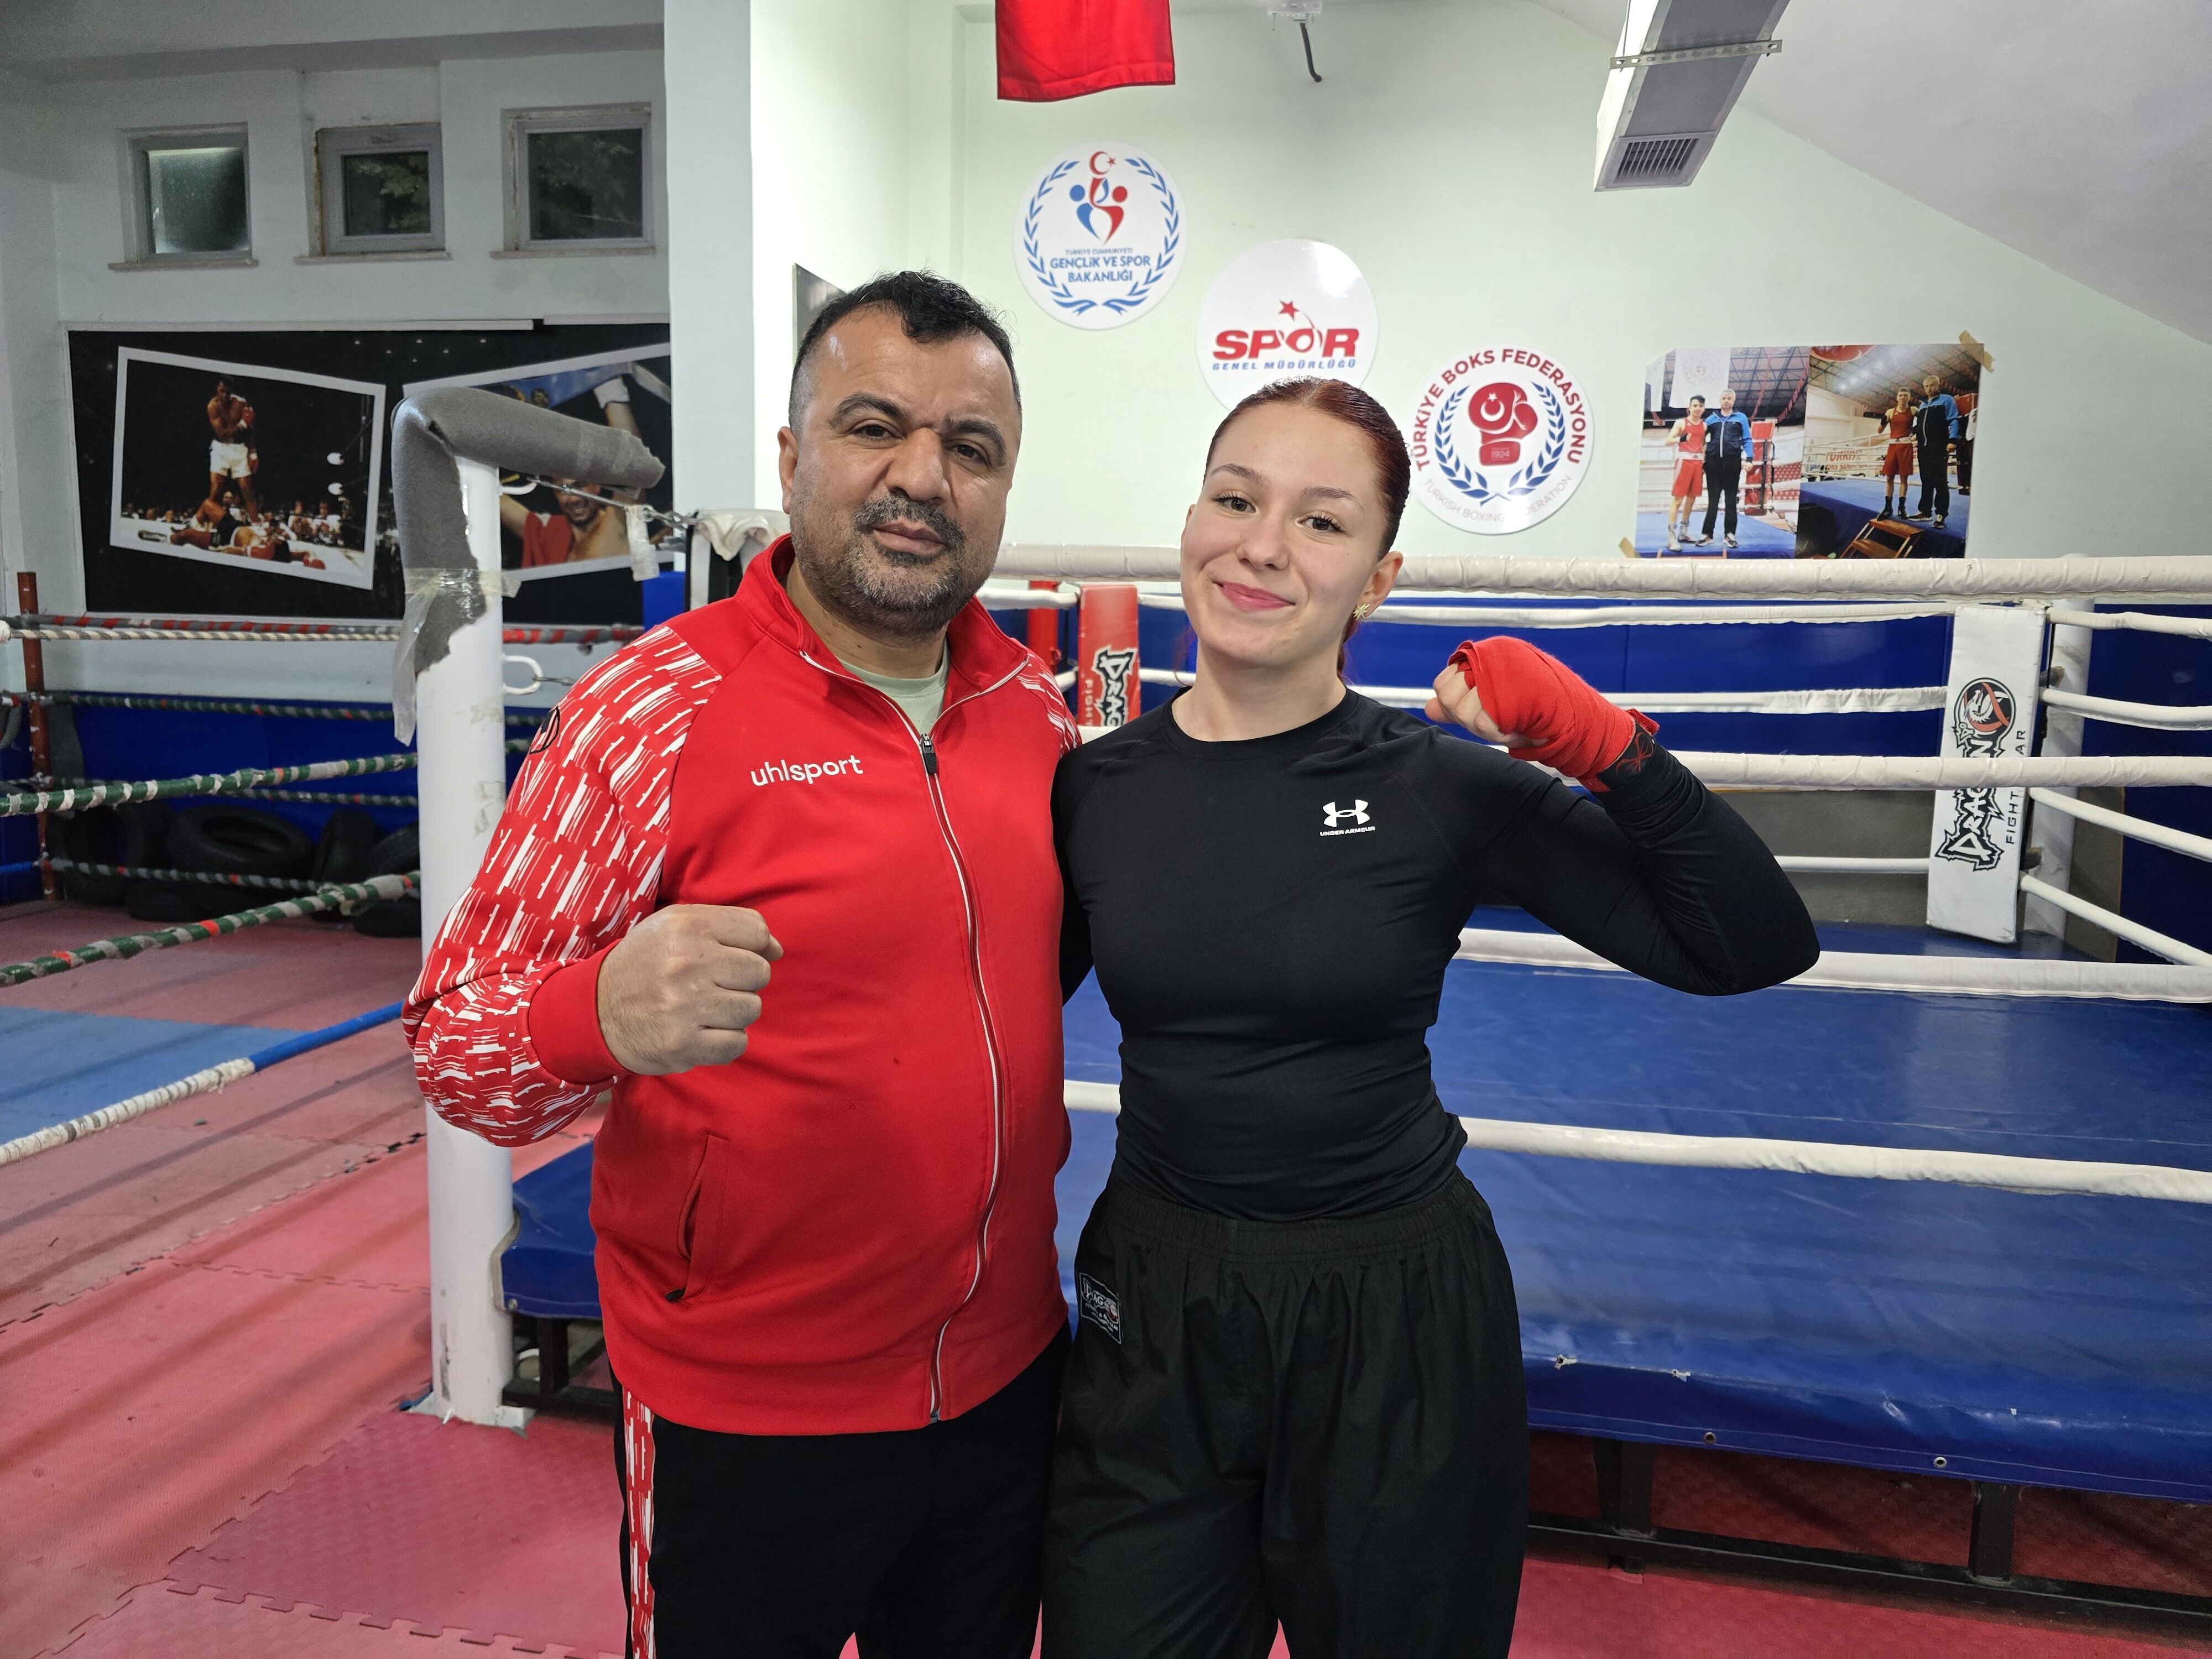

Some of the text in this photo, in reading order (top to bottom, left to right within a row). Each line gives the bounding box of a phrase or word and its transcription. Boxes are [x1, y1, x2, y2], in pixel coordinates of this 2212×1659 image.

[1068, 269, 1133, 283] BAKANLIĞI
[1103, 257, 1118, 267] VE
[1120, 255, 1151, 267] SPOR
[1213, 328, 1359, 361] SPOR
[1212, 359, 1356, 371] GENEL MÜDÜRLÜĞÜ
[1411, 348, 1587, 471] TÜRKİYE BOKS FEDERASYONU
[1425, 478, 1462, 513] TURKISH
[750, 755, 864, 786] uhlsport
[1344, 826, 1376, 834] ARMOUR
[2006, 791, 2020, 844] FIGHT
